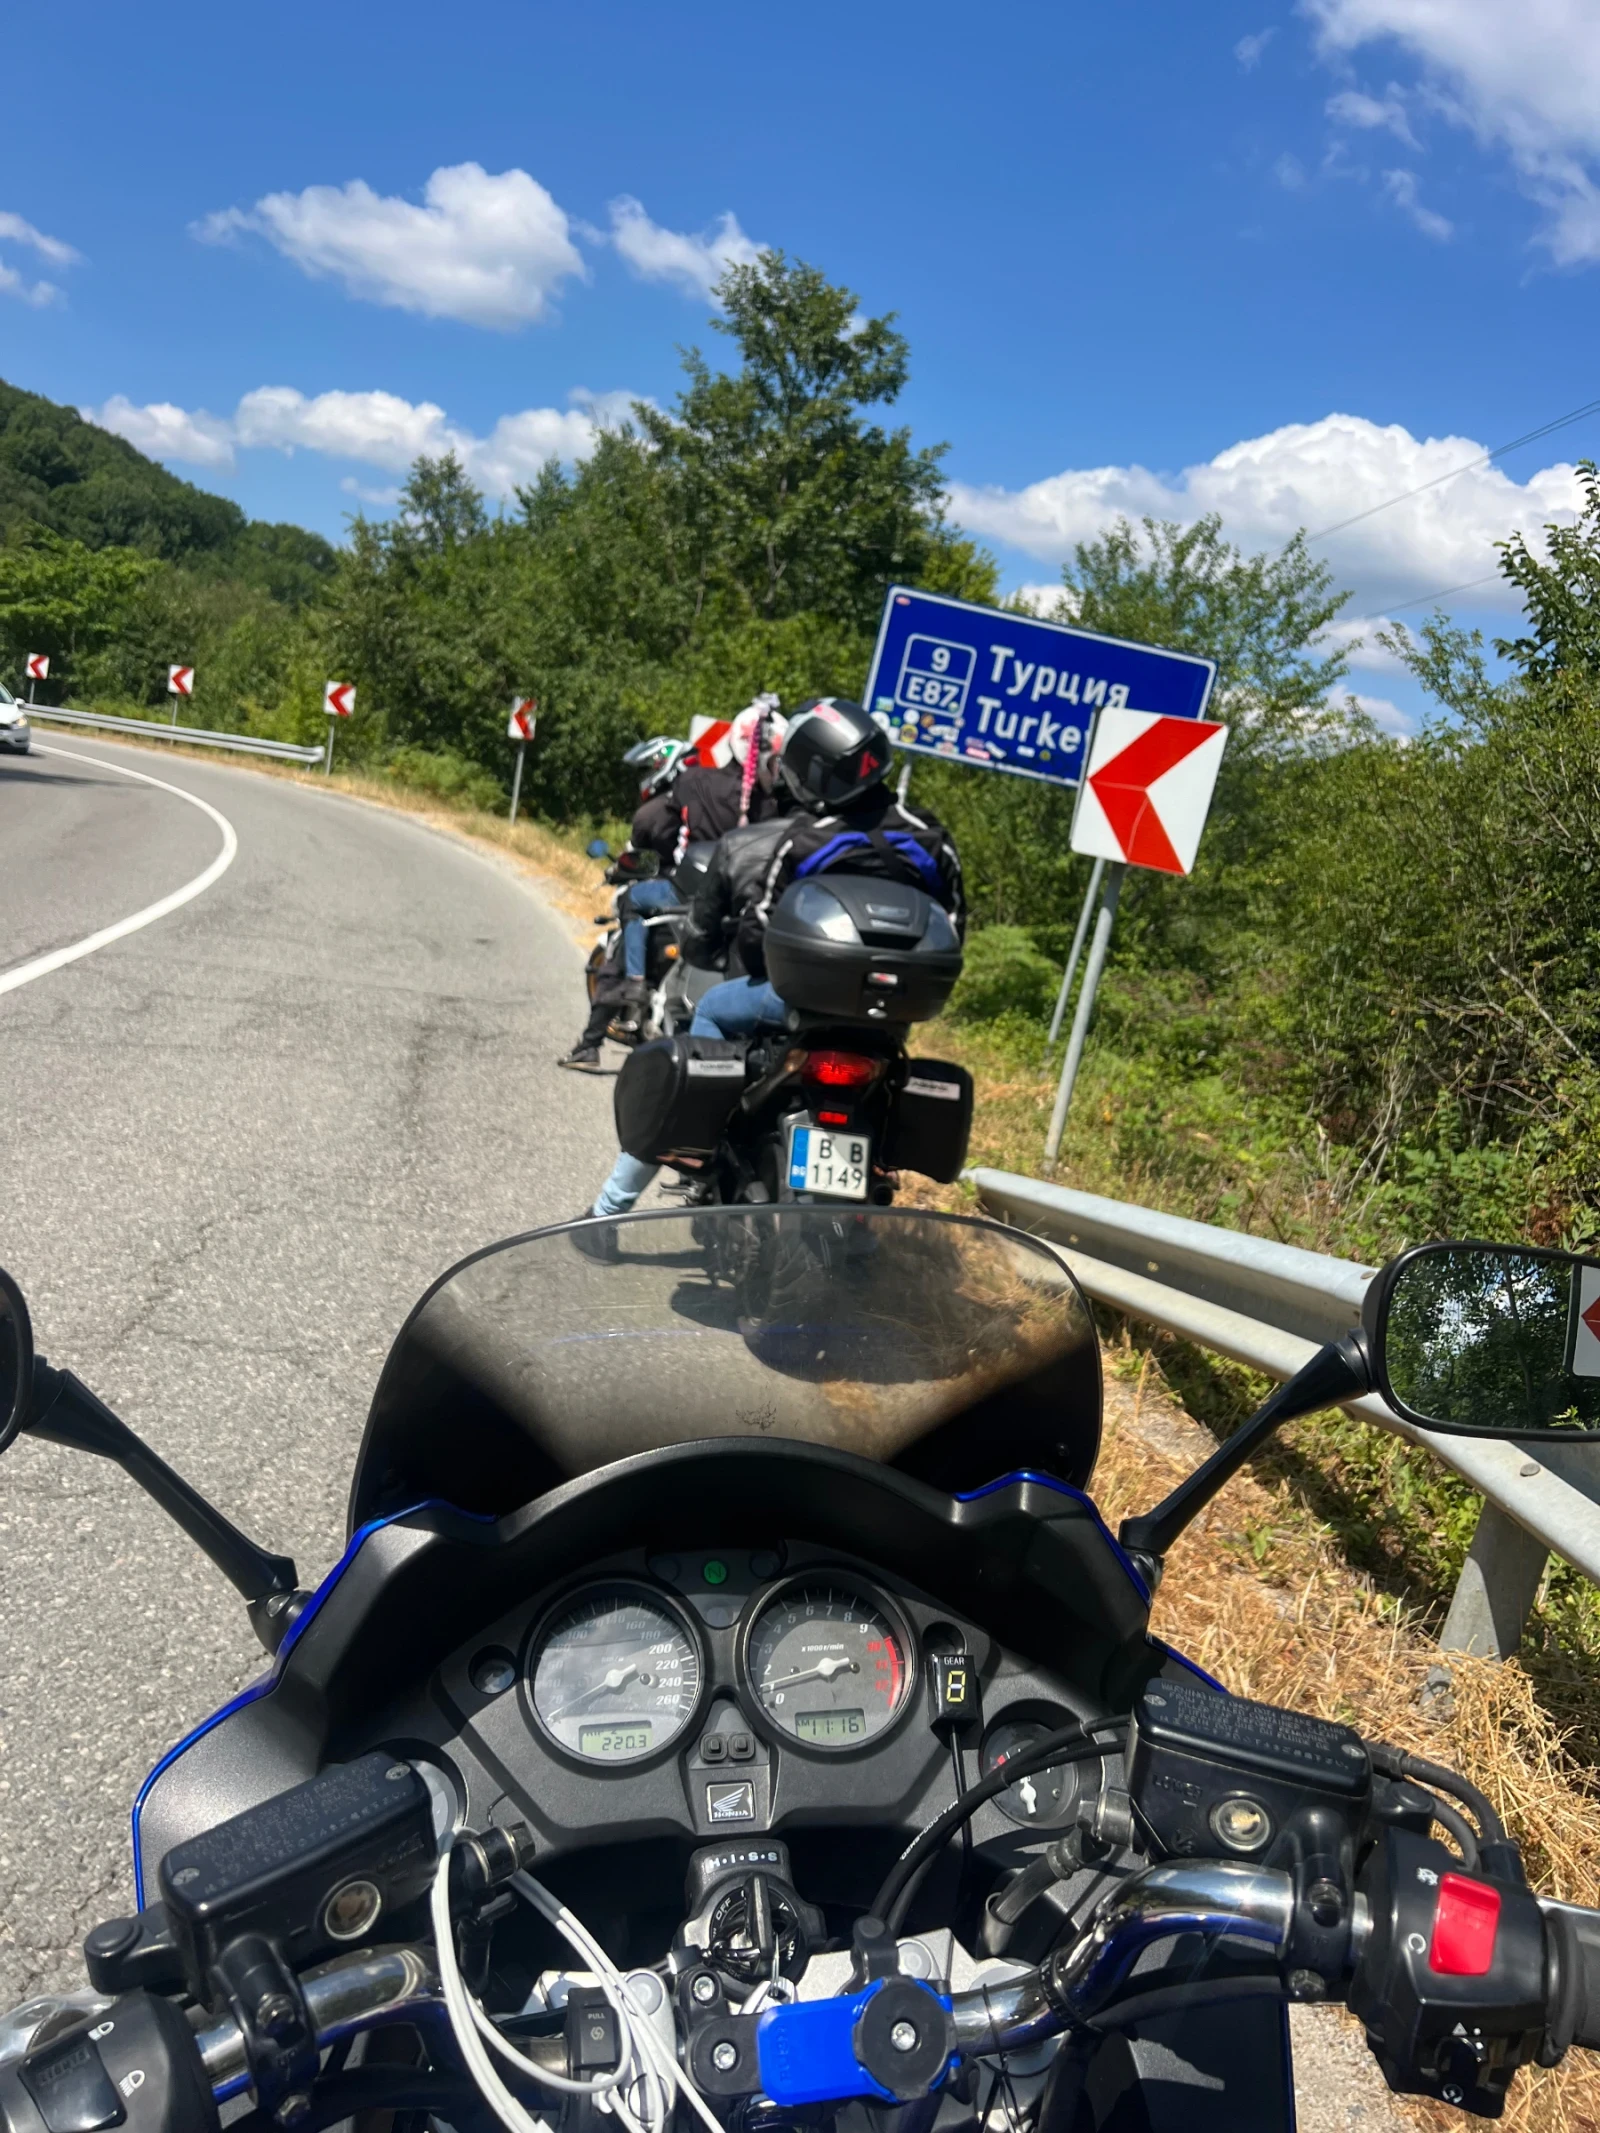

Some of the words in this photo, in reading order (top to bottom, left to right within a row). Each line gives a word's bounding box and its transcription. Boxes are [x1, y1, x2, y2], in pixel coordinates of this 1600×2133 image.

[931, 647, 952, 673] 9
[990, 644, 1131, 709] Турция
[905, 676, 960, 708] E87
[976, 695, 1091, 754] Turke
[820, 1138, 832, 1159] B
[850, 1142, 863, 1164] B
[813, 1162, 863, 1190] 1149
[707, 1565, 721, 1578] N
[806, 1605, 814, 1616] 6
[826, 1605, 834, 1616] 7
[788, 1613, 797, 1624] 5
[844, 1612, 852, 1622] 8
[773, 1624, 782, 1635] 4
[859, 1624, 869, 1634] 9
[649, 1643, 672, 1654] 200
[764, 1643, 772, 1654] 3
[656, 1659, 679, 1670] 220
[944, 1656, 965, 1666] GEAR
[764, 1664, 772, 1675] 2
[658, 1677, 682, 1688] 240
[656, 1694, 680, 1705] 260
[775, 1693, 785, 1704] 0
[812, 1716, 860, 1736] 11:16
[601, 1735, 648, 1751] 220.3
[713, 1810, 749, 1819] HONDA
[715, 1896, 732, 1922] OFF
[588, 2012, 606, 2020] PULL
